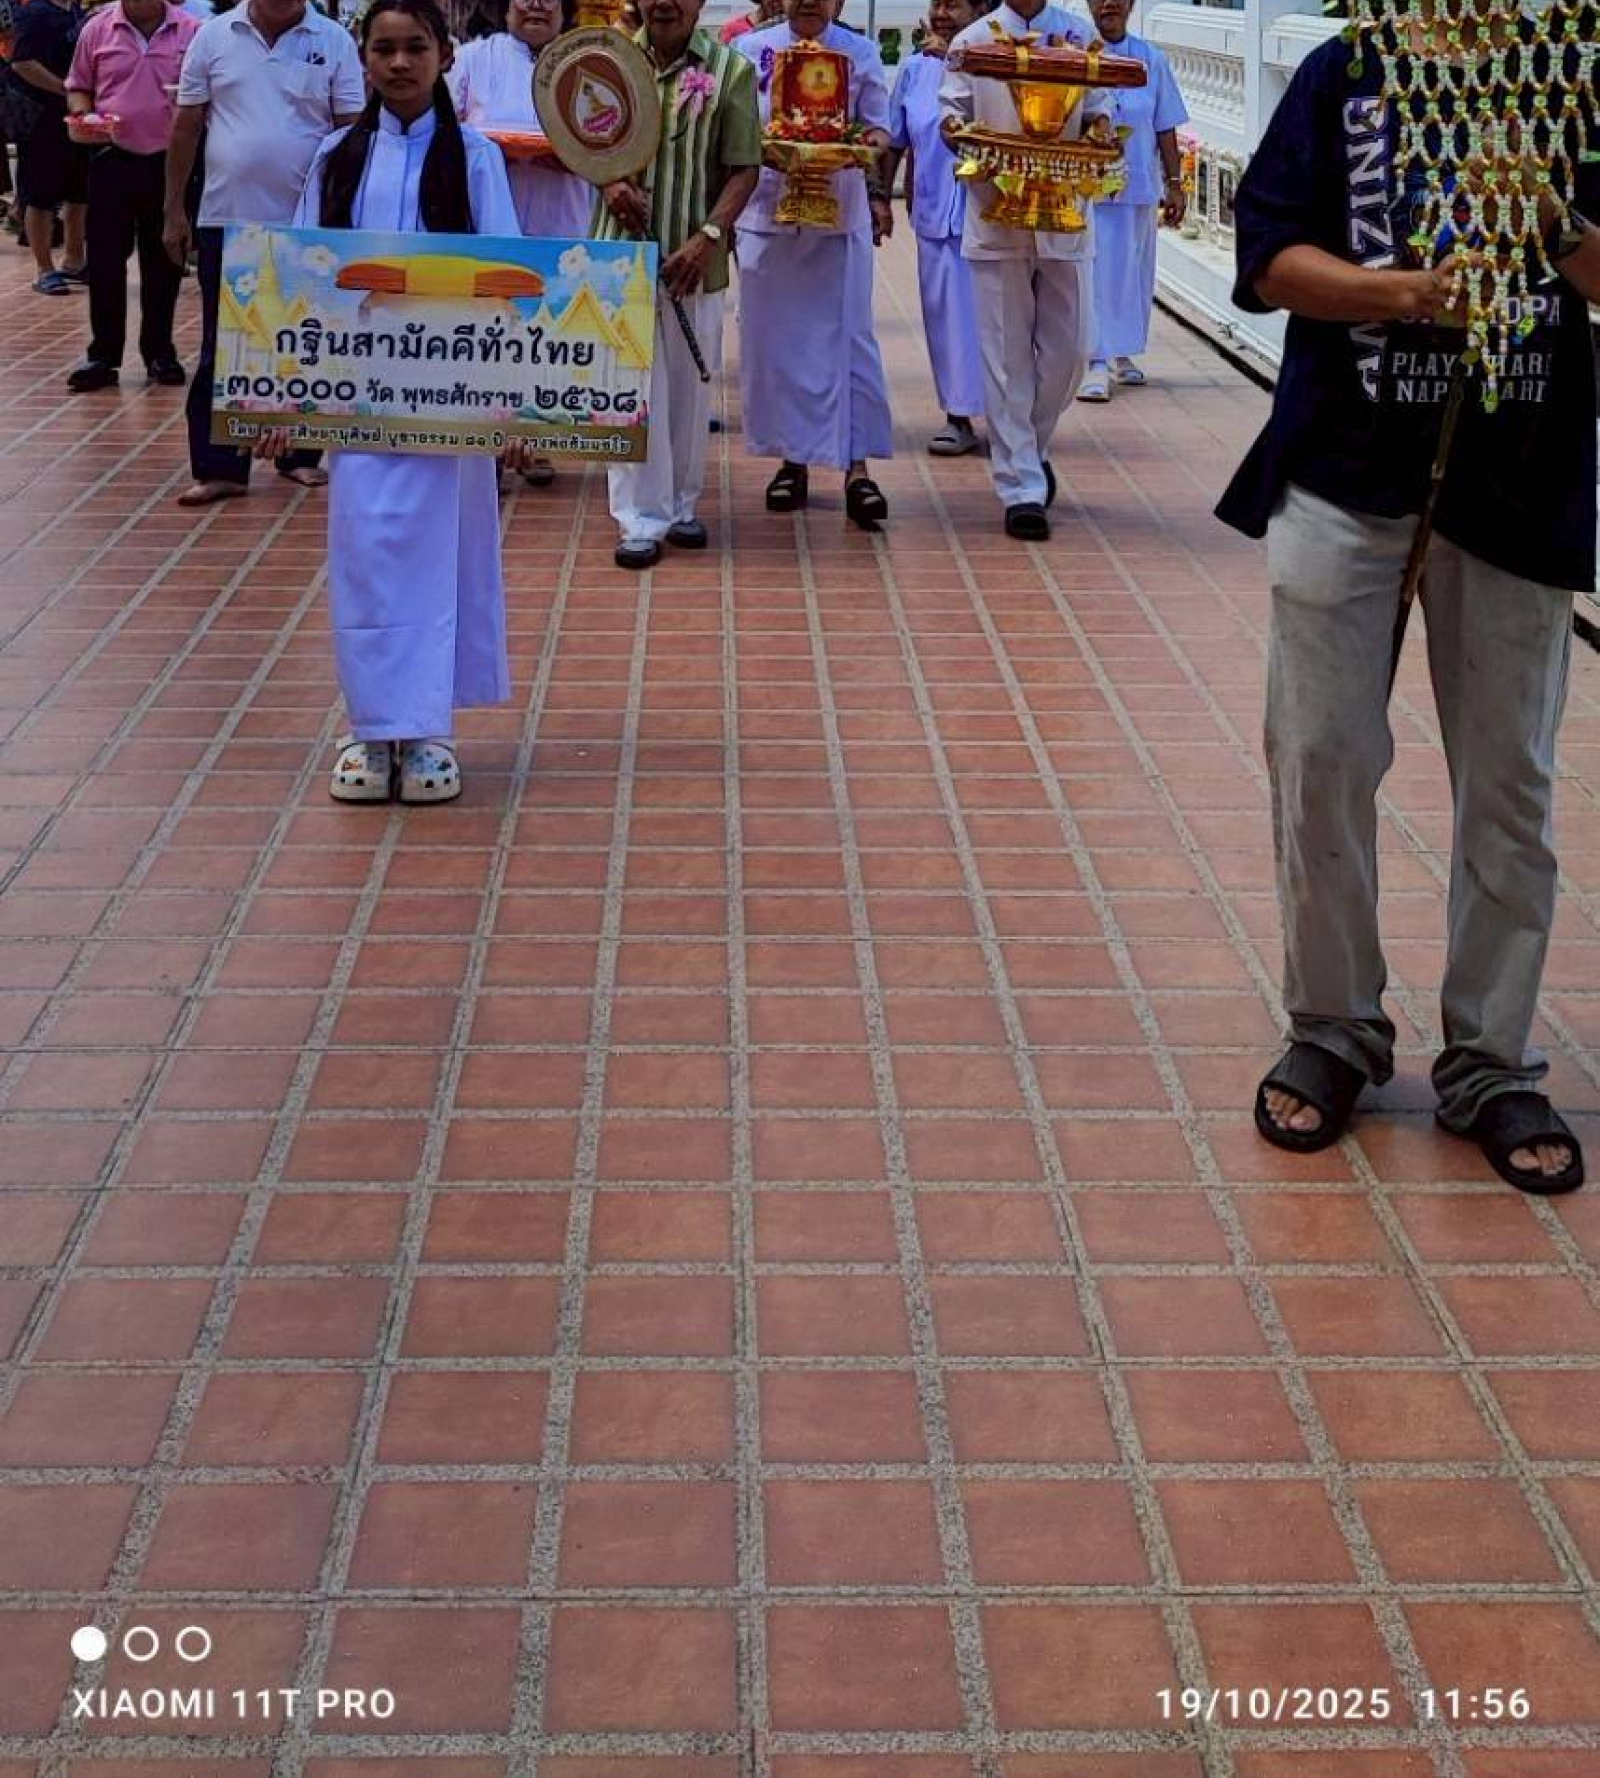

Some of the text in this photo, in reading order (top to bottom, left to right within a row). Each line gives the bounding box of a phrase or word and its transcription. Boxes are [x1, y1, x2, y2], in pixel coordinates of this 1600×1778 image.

[275, 316, 595, 366] กฐินสามัคคีทั่วไทย
[227, 373, 637, 415] ๓๐,๐๐๐ วัด พุทธศักราช ๒๕๖๘
[1396, 379, 1464, 402] NAP
